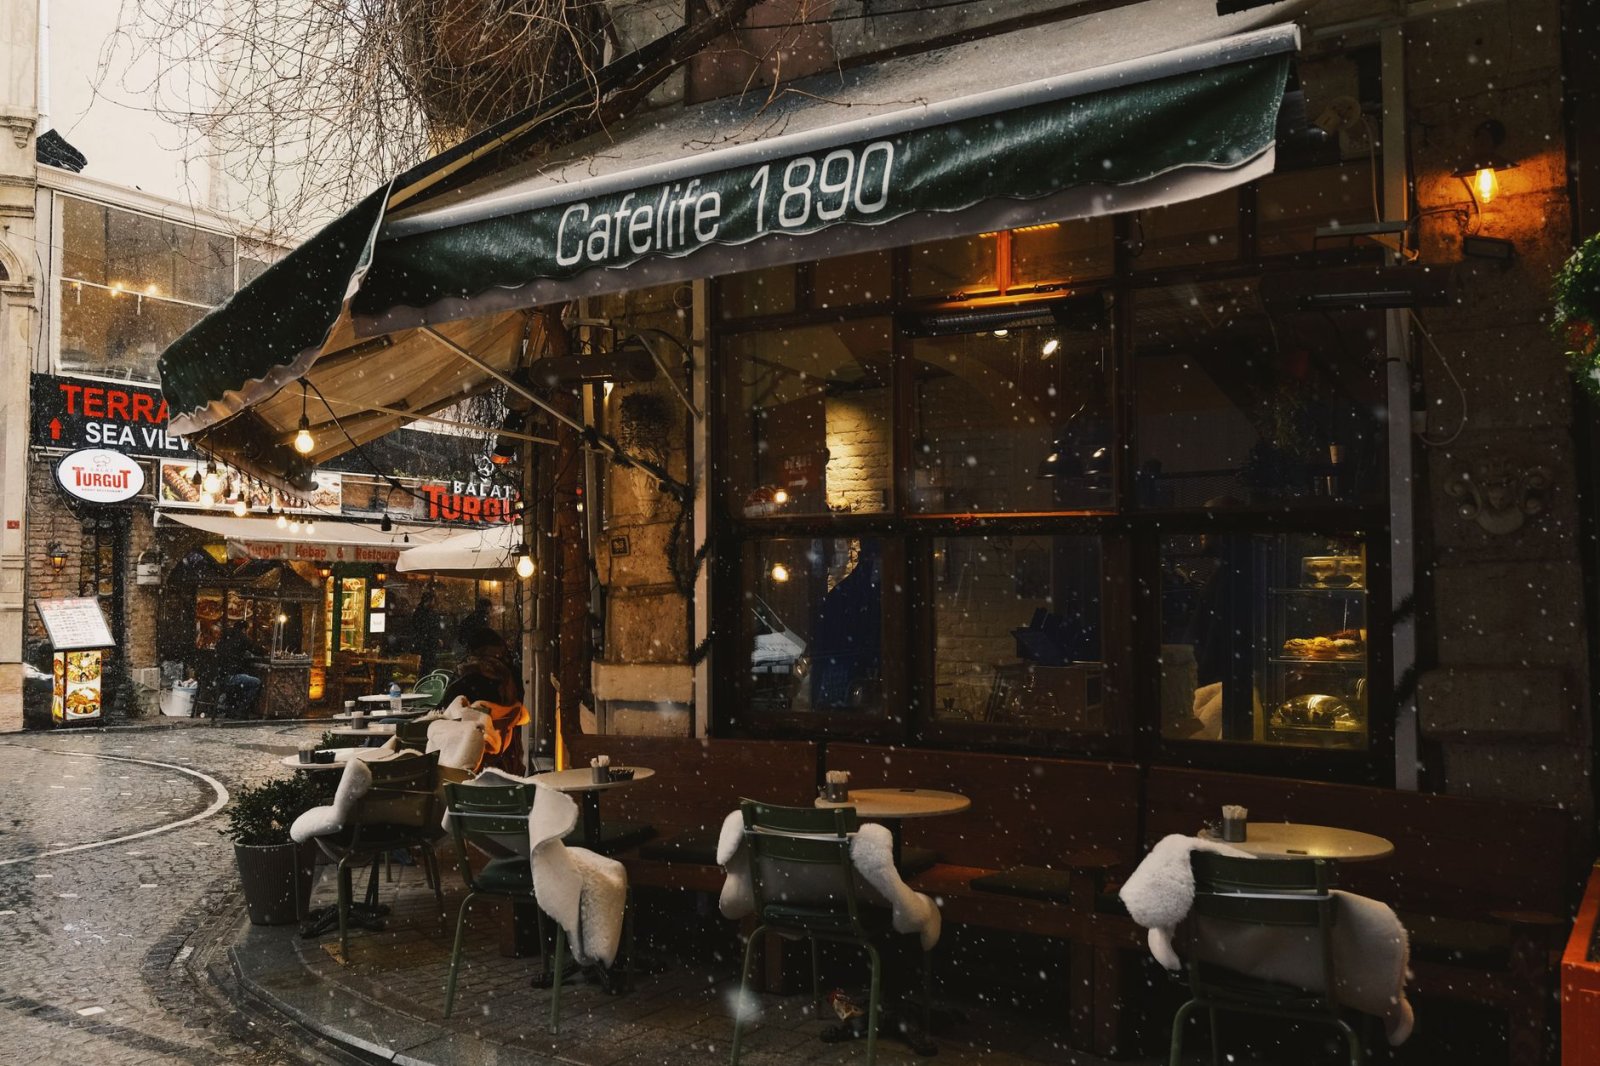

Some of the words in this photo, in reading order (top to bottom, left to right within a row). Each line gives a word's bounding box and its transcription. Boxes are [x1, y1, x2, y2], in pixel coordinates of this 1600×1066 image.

[556, 178, 721, 267] Cafelife
[750, 140, 895, 233] 1890
[85, 421, 136, 446] SEA
[453, 480, 512, 498] BALAT
